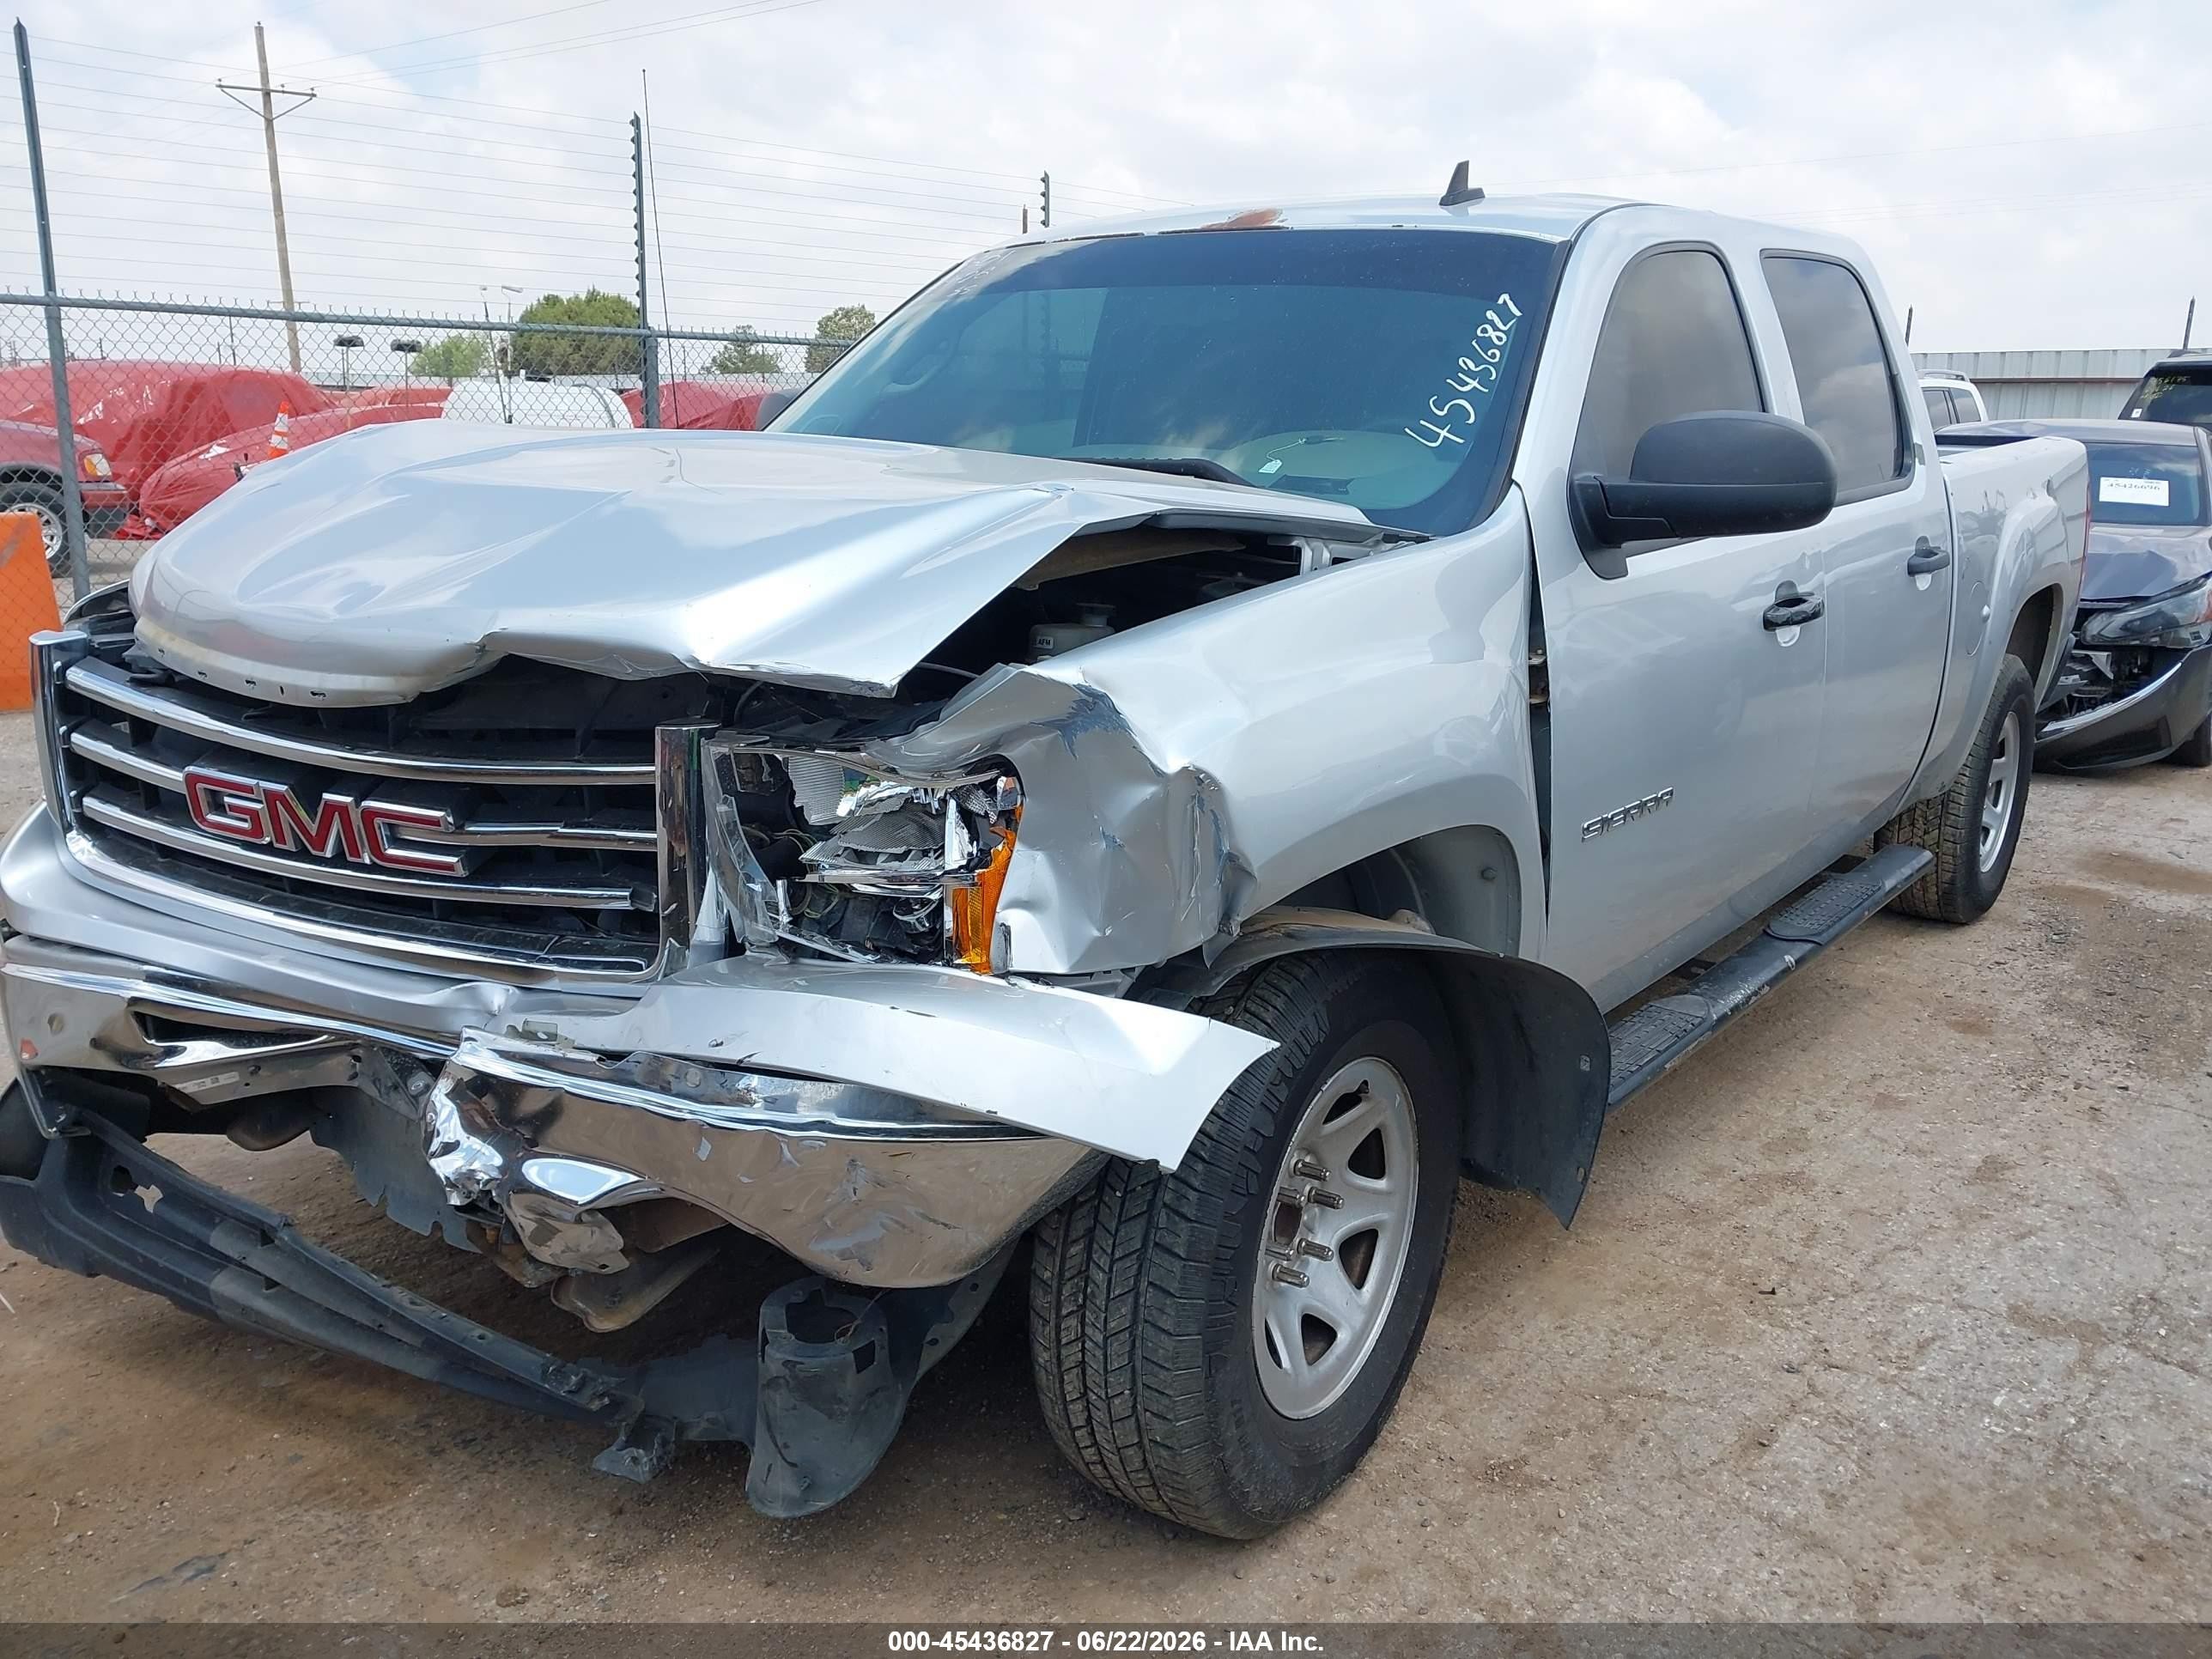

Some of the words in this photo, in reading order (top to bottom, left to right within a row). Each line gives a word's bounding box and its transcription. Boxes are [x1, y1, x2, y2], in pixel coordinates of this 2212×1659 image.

[1403, 293, 1523, 447] 45436827
[182, 765, 470, 878] GMC
[1581, 787, 1674, 842] SIERRA
